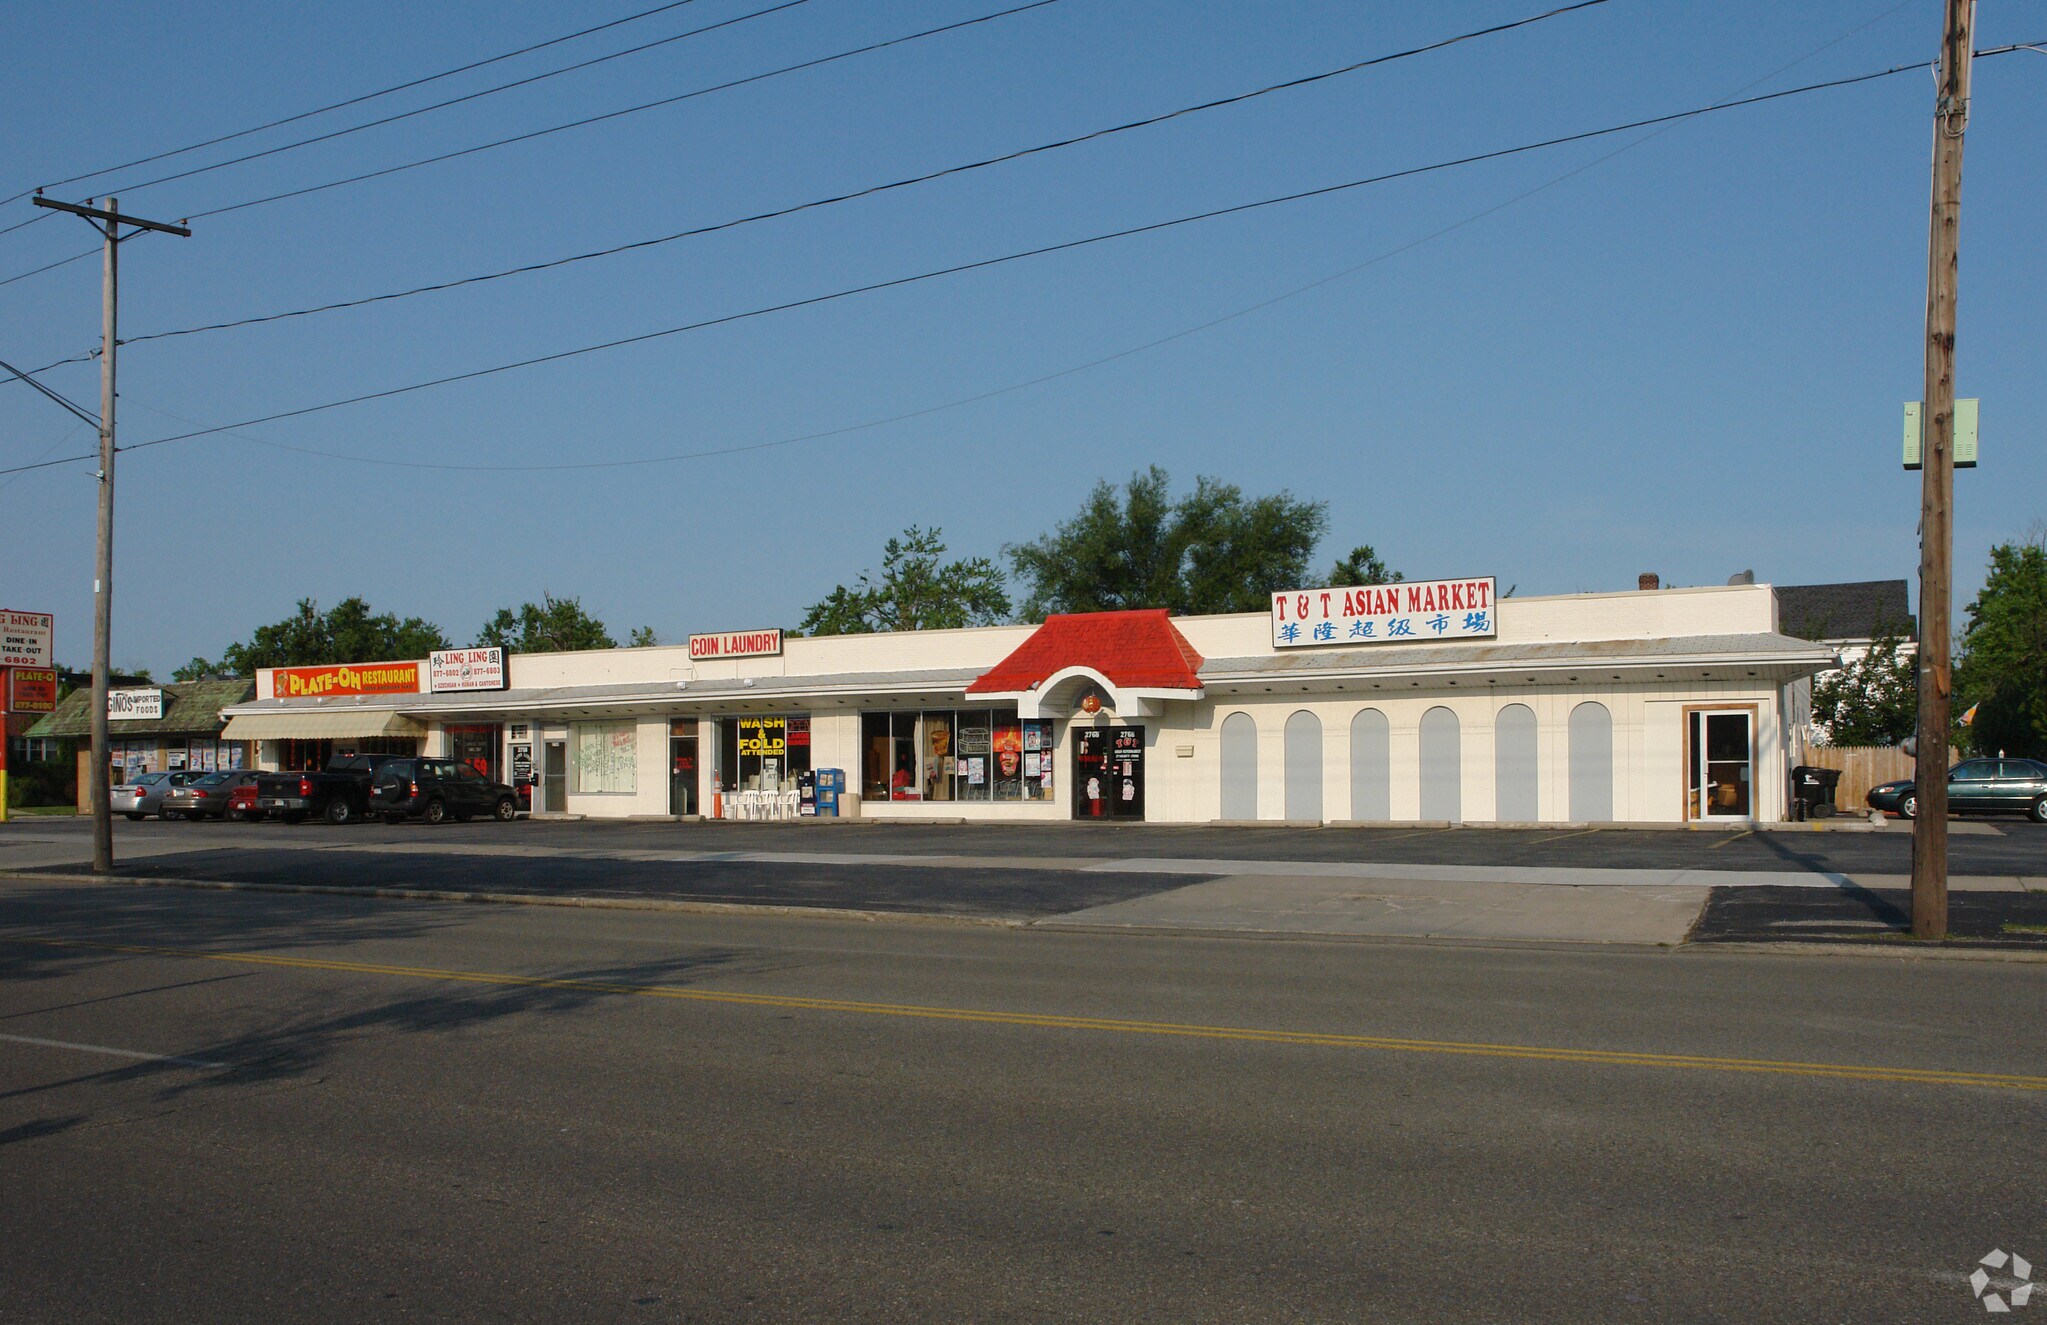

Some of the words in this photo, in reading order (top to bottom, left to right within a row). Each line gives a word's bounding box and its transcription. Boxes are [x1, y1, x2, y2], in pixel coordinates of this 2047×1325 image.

[1276, 595, 1288, 621] T
[1297, 593, 1309, 620] &
[1320, 592, 1331, 619] T
[1342, 588, 1400, 617] ASIAN
[1407, 581, 1490, 613] MARKET
[11, 615, 38, 627] LING
[6, 637, 26, 645] DINE
[690, 637, 719, 656] COIN
[723, 632, 779, 655] LAUNDRY
[1, 645, 22, 653] TAKE
[445, 652, 464, 665] LING
[468, 651, 487, 664] LING
[289, 667, 361, 695] PLATE-OH
[362, 668, 417, 685] RESTAURANT
[136, 705, 159, 714] FOODS
[740, 717, 785, 729] WASH
[757, 728, 767, 739] &
[739, 738, 785, 750] FOLD
